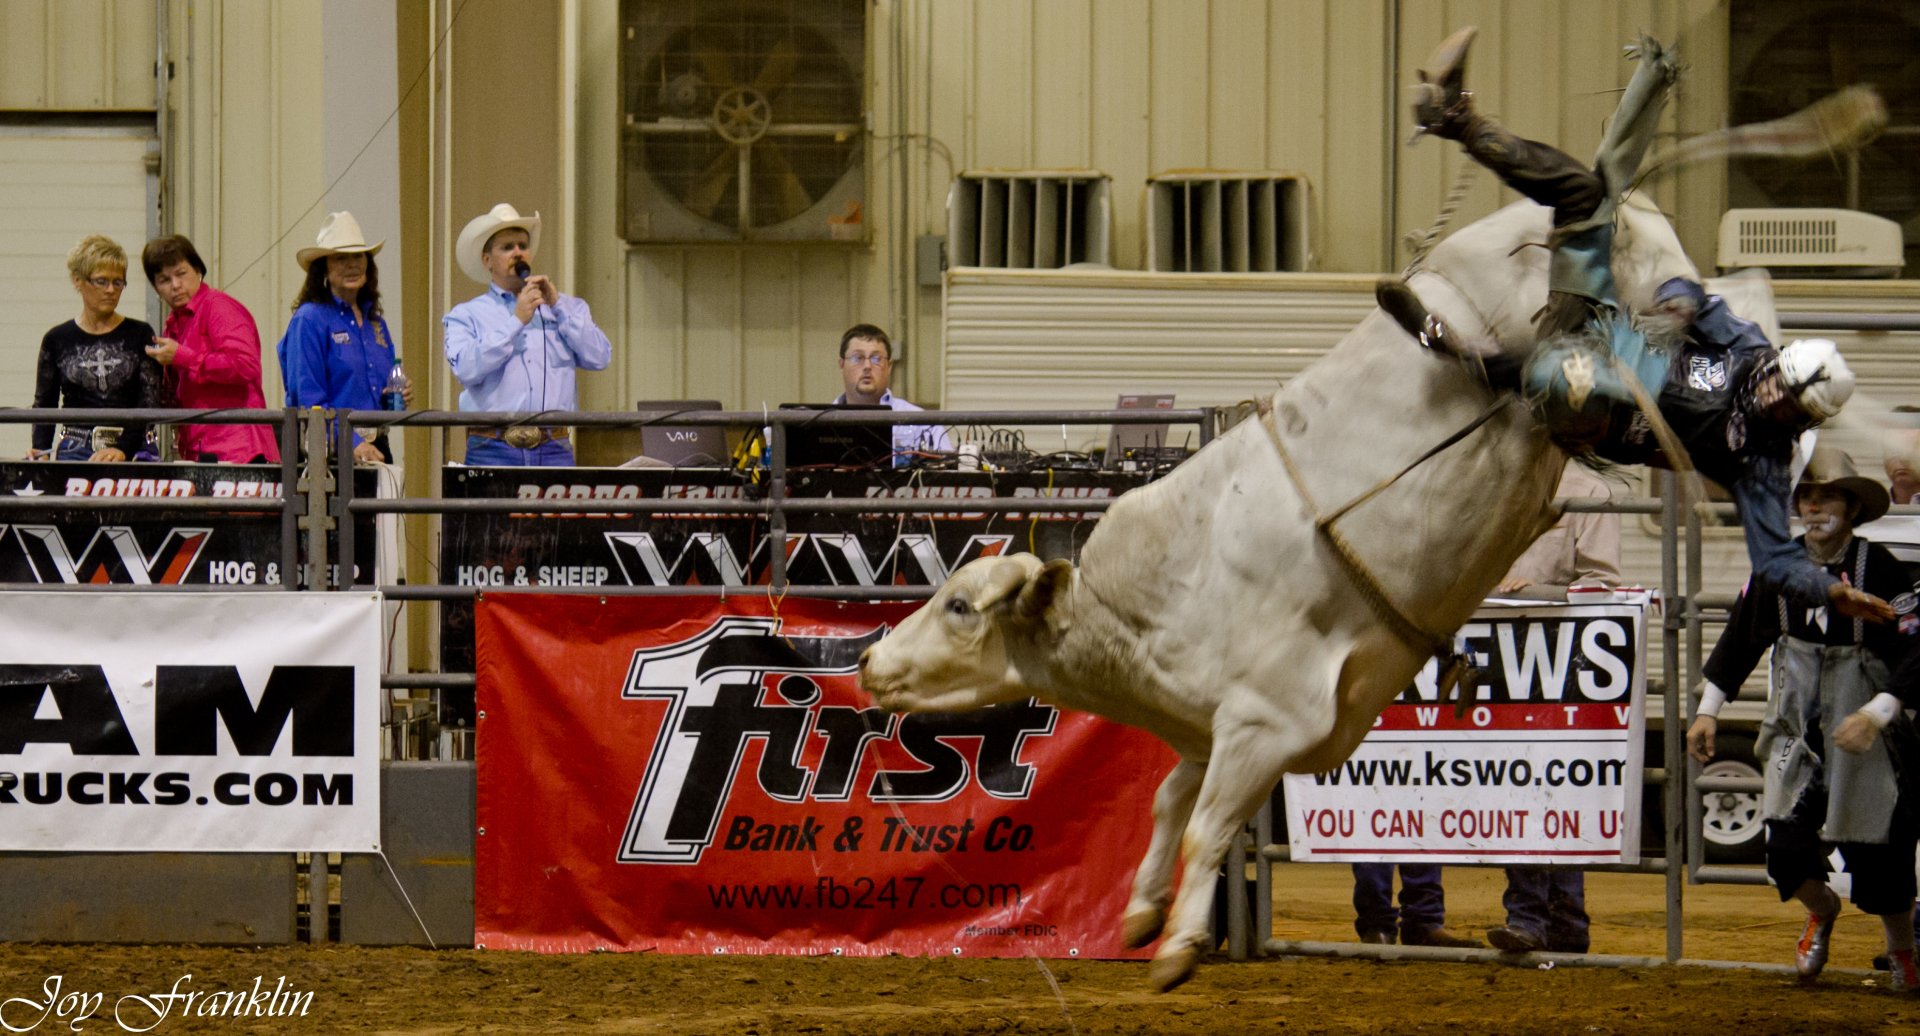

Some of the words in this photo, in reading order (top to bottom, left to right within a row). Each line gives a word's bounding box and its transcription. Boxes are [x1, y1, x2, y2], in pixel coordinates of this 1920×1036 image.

[209, 561, 256, 584] HOG
[265, 562, 280, 585] &
[458, 565, 505, 586] HOG
[514, 565, 529, 586] &
[538, 565, 609, 586] SHEEP
[724, 816, 820, 852] Bank
[833, 817, 864, 853] &
[879, 817, 974, 853] Trust
[983, 817, 1035, 853] Co.
[1303, 809, 1354, 838] YOU
[1371, 809, 1423, 838] CAN
[1440, 809, 1529, 839] COUNT
[1543, 810, 1580, 839] ON
[708, 877, 1022, 911] www.fb247.com
[965, 925, 1019, 937] Member
[1024, 925, 1058, 937] FDIC
